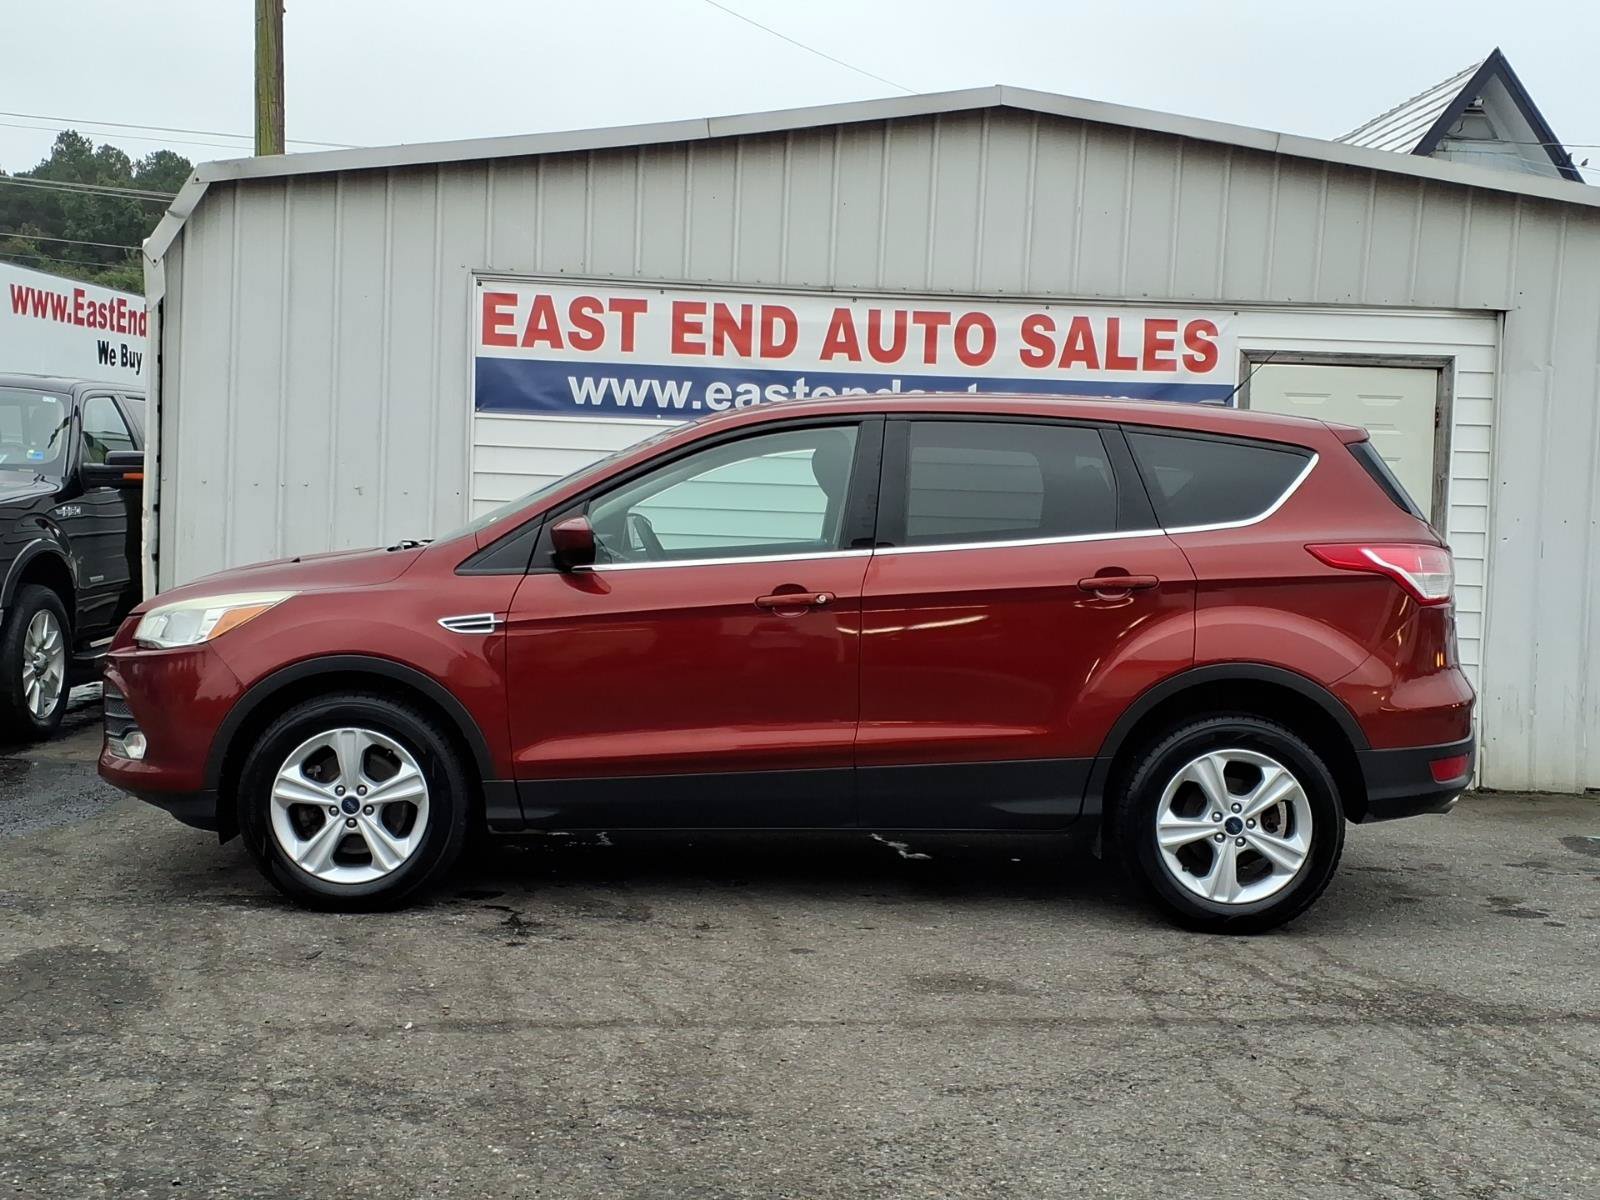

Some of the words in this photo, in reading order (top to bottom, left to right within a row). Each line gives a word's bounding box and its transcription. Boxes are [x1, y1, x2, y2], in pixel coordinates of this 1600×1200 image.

[97, 340, 117, 366] We
[120, 343, 143, 375] Buy
[482, 292, 648, 352] EAST
[671, 300, 799, 359] END
[819, 307, 997, 367] AUTO
[1019, 313, 1219, 373] SALES
